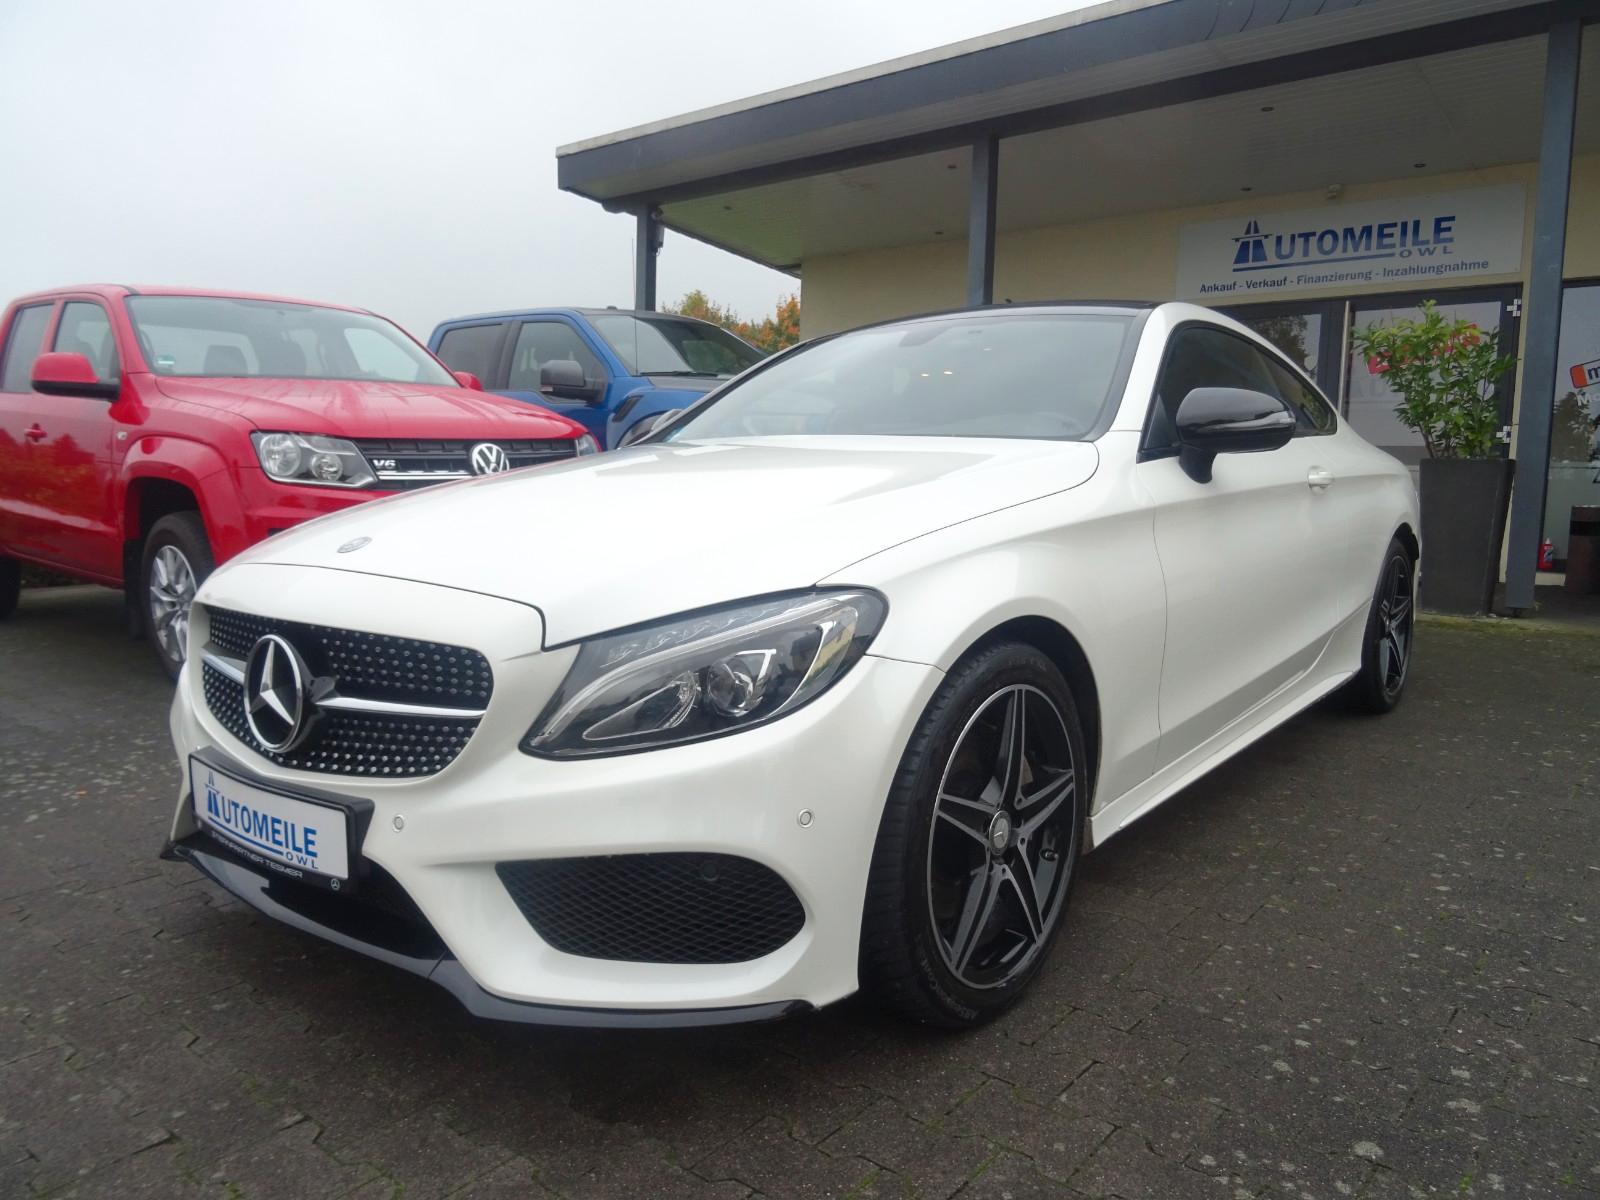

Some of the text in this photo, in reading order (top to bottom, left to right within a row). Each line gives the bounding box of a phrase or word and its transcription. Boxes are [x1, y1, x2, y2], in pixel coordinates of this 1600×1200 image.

[1399, 245, 1454, 258] OWL
[1199, 281, 1237, 294] Ankauf
[1245, 276, 1288, 289] Verkauf
[1296, 270, 1373, 286] Finanzierung
[1382, 259, 1489, 278] Inzahlungnahme
[373, 459, 396, 469] V6
[286, 851, 319, 870] OWL
